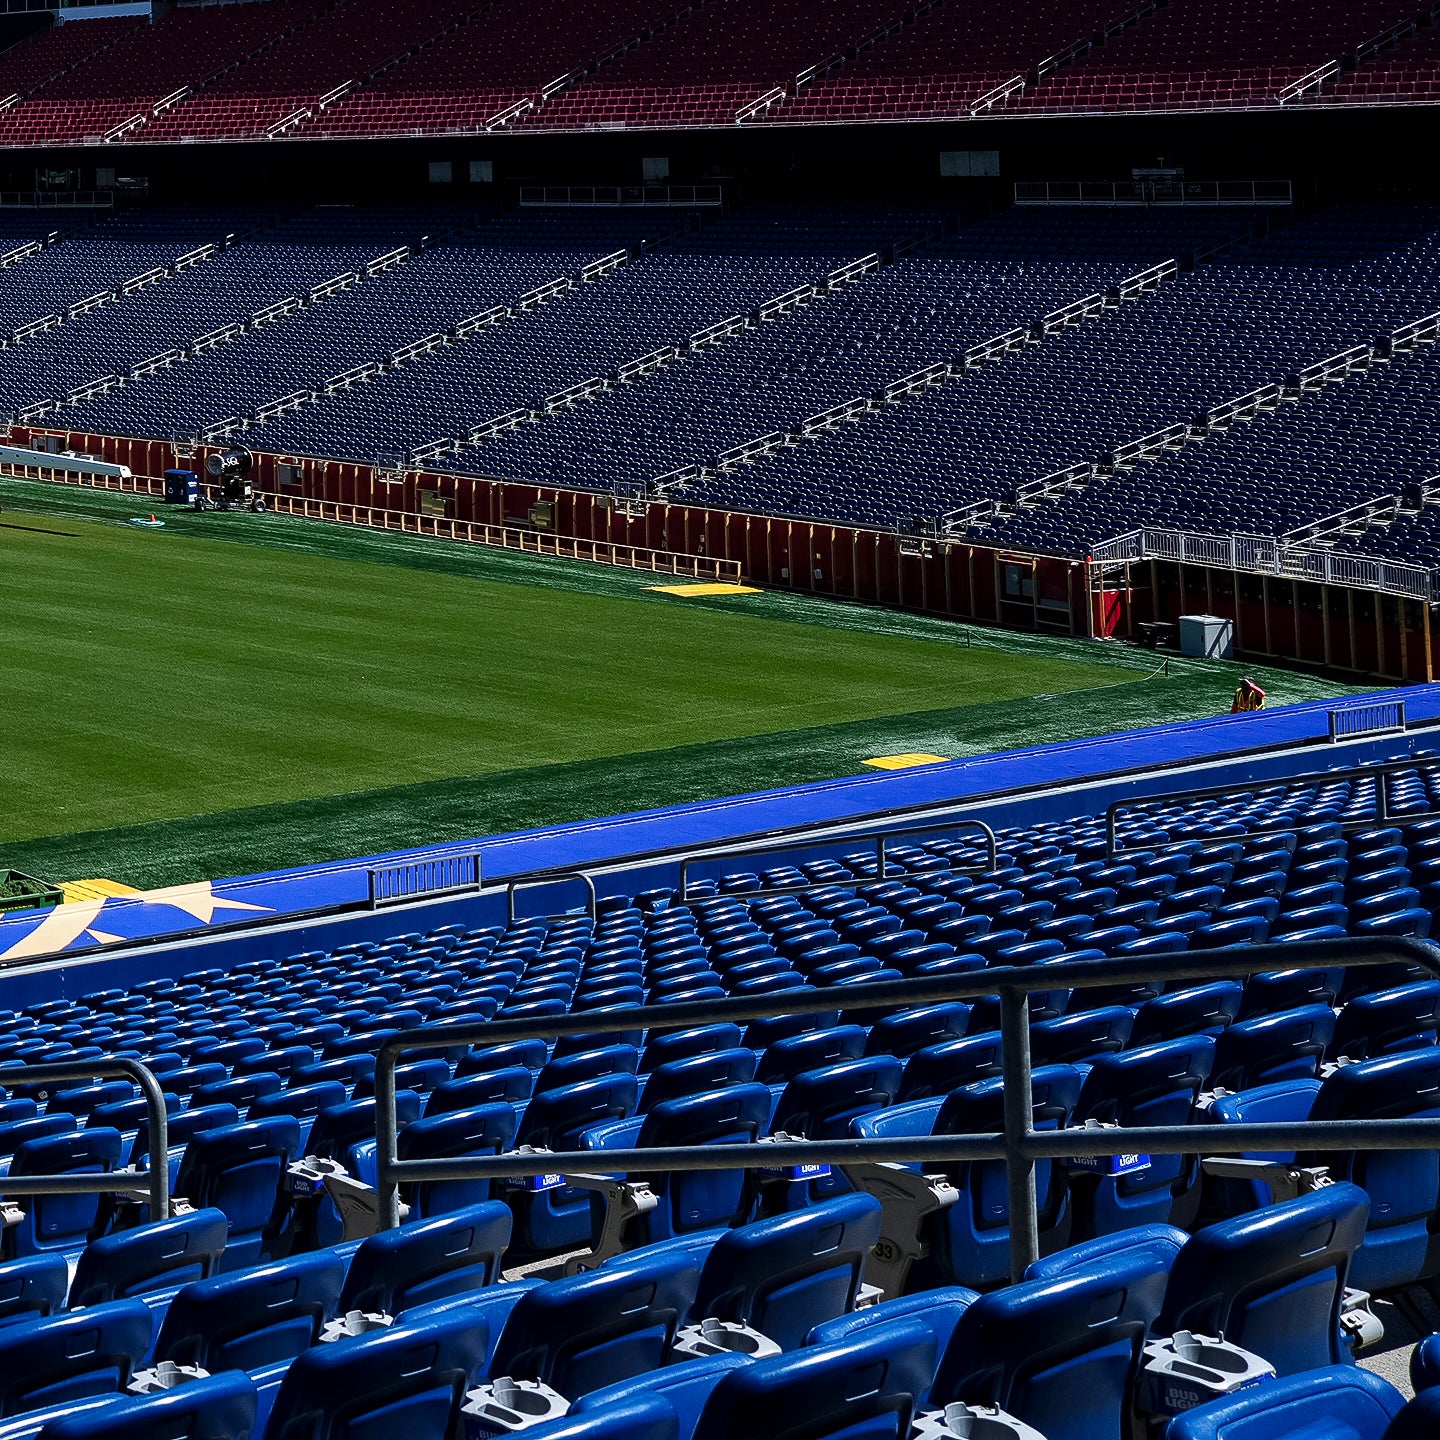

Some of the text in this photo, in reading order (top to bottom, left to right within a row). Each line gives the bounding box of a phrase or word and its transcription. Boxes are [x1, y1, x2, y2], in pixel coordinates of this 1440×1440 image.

[1119, 1154, 1139, 1167] LIGHT
[801, 1164, 820, 1173] LIGHT
[542, 1174, 561, 1186] LIGHT
[294, 1184, 310, 1192] LIGHT
[875, 1242, 893, 1259] 33
[1169, 1388, 1199, 1401] BUD
[1164, 1396, 1201, 1410] LIGH
